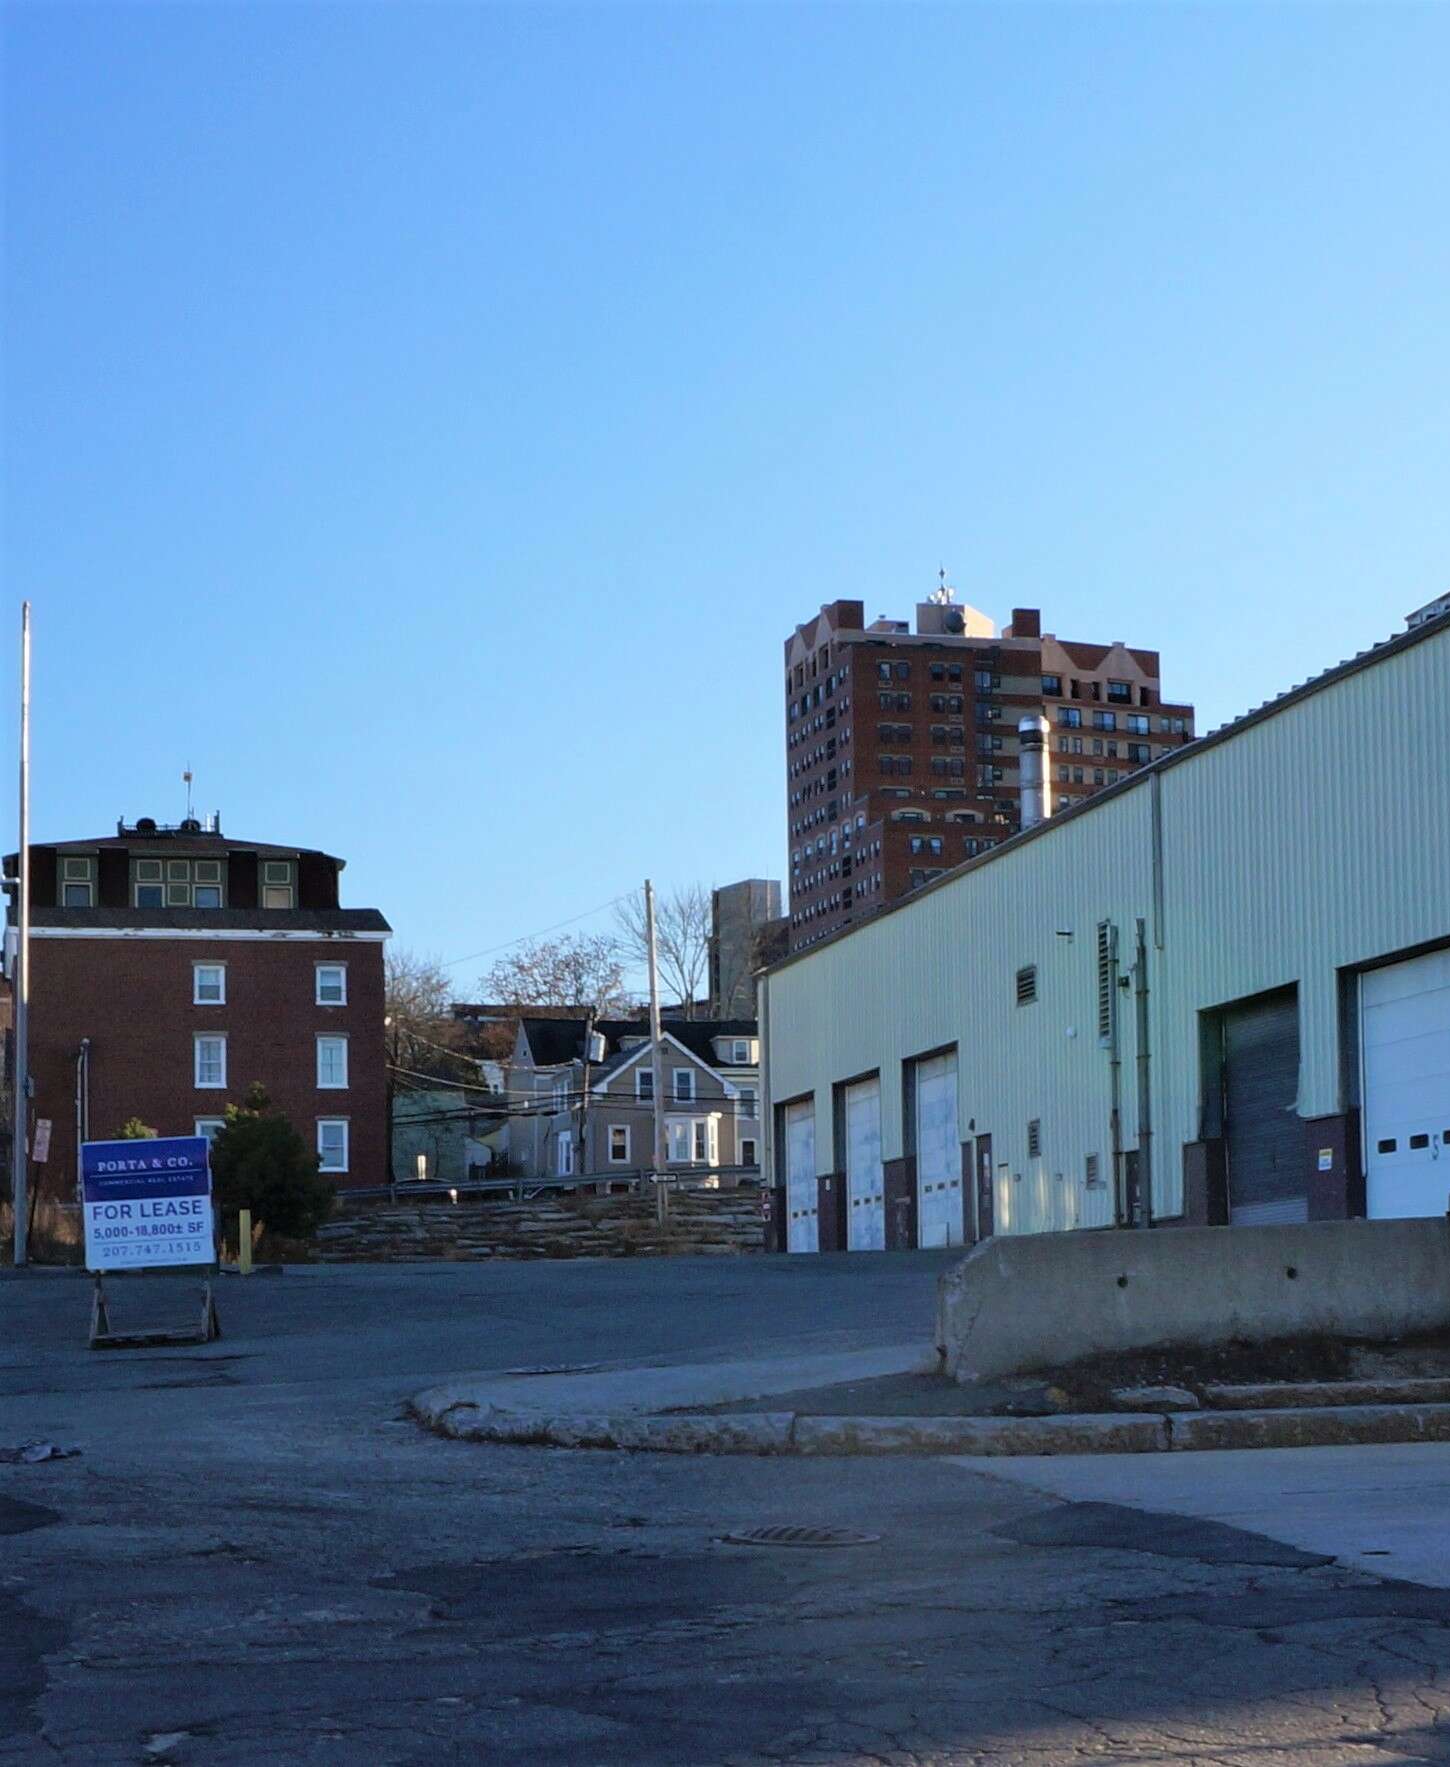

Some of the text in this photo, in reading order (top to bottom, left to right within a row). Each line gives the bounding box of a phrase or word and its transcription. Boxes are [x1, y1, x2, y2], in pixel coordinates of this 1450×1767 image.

[97, 1156, 193, 1172] PORTA & CO.
[93, 1199, 203, 1220] FOR LEASE
[187, 1221, 205, 1233] SF
[103, 1241, 201, 1257] 207.747.1515
